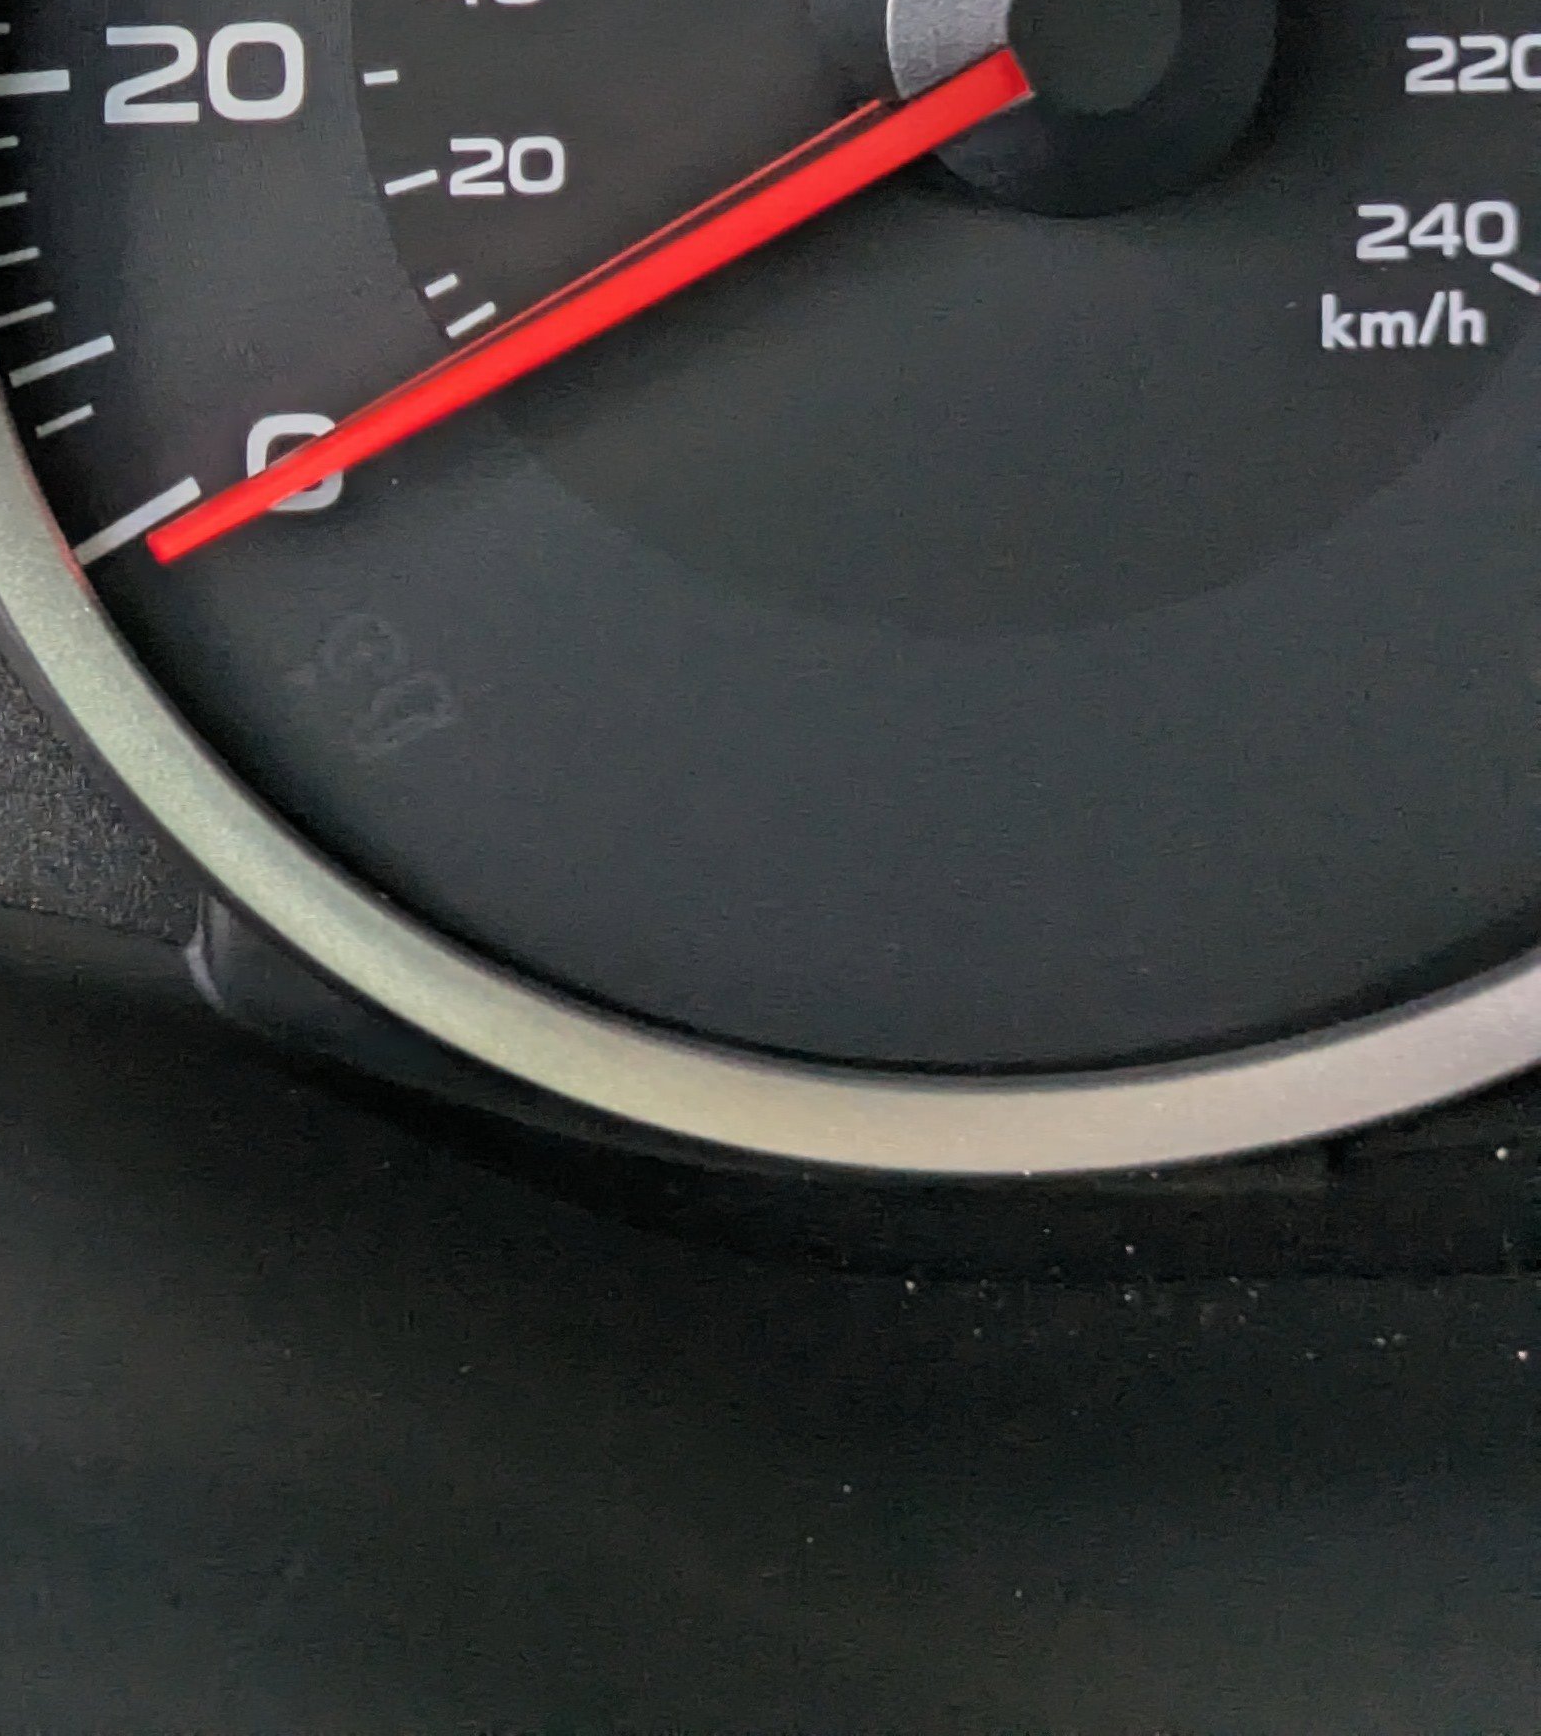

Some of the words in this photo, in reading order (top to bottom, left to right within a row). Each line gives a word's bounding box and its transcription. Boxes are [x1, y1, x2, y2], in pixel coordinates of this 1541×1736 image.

[104, 21, 305, 124] 20
[449, 135, 566, 196] 20
[1356, 200, 1518, 260] 240
[1321, 289, 1486, 349] km/h
[246, 412, 345, 512] 0
